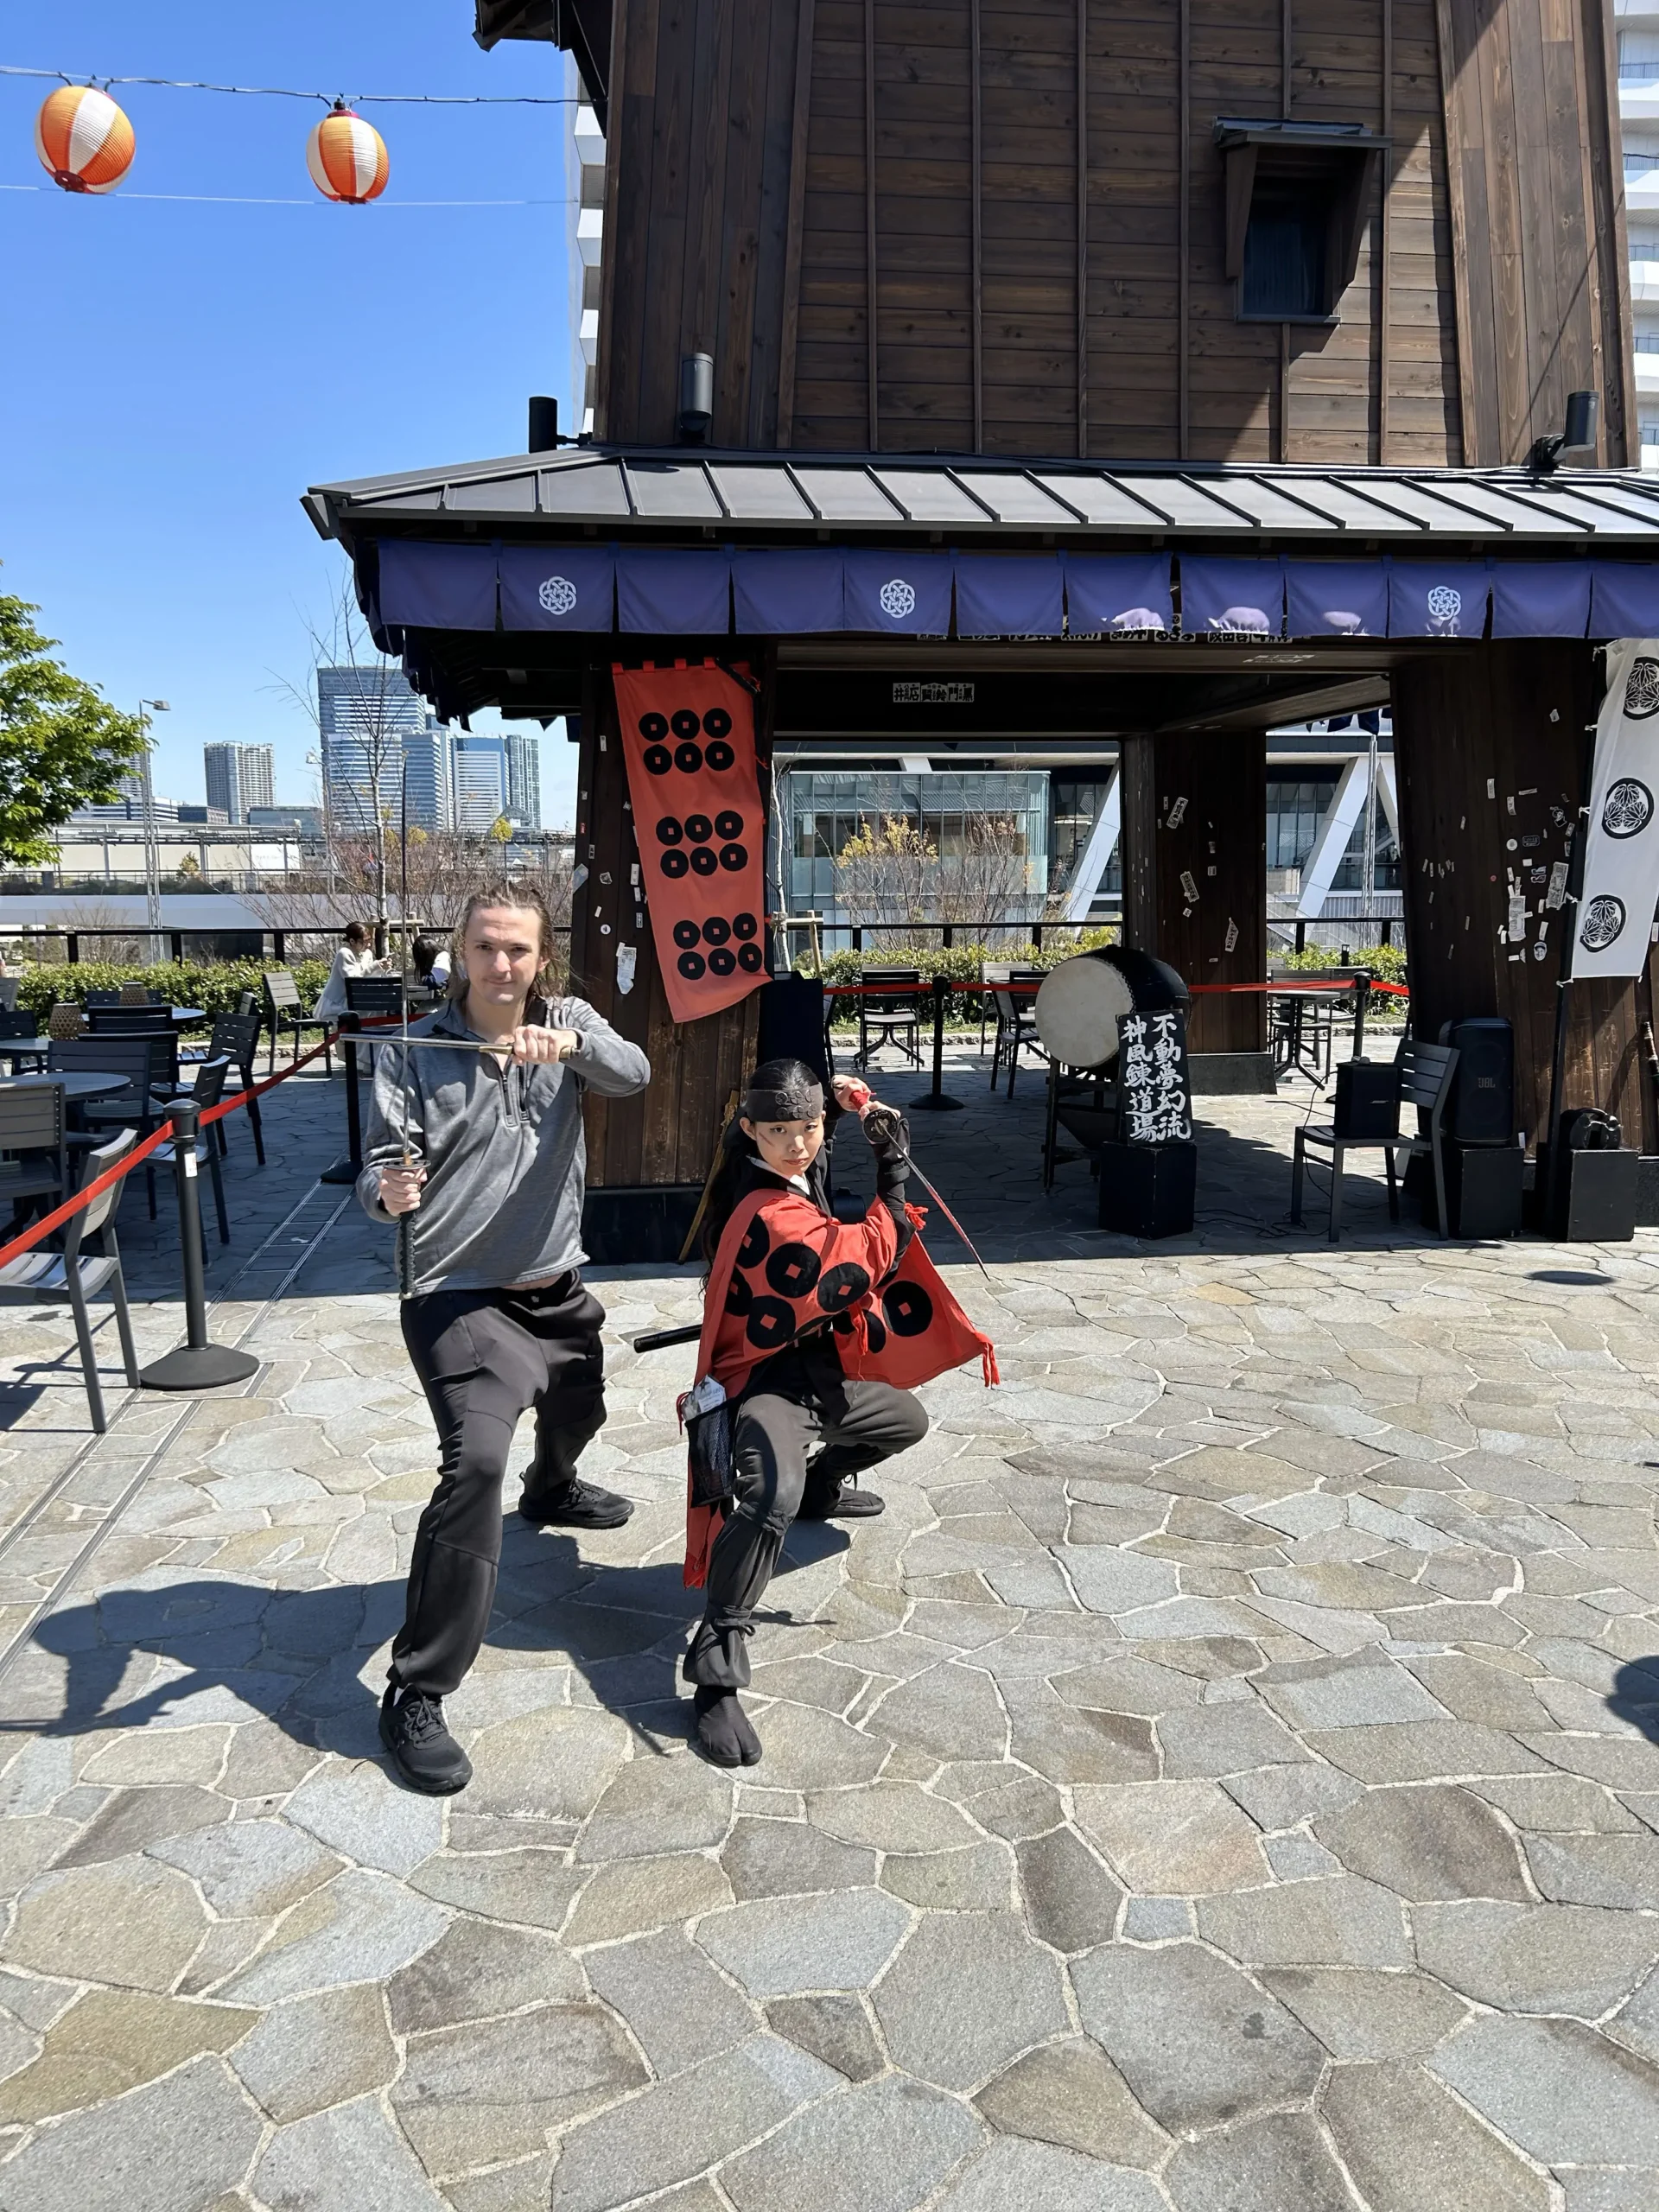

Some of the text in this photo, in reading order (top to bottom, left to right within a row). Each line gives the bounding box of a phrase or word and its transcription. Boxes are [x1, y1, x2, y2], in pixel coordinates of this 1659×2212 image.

[1152, 1013, 1192, 1141] 不動夢幻流
[1478, 1077, 1496, 1088] JBL
